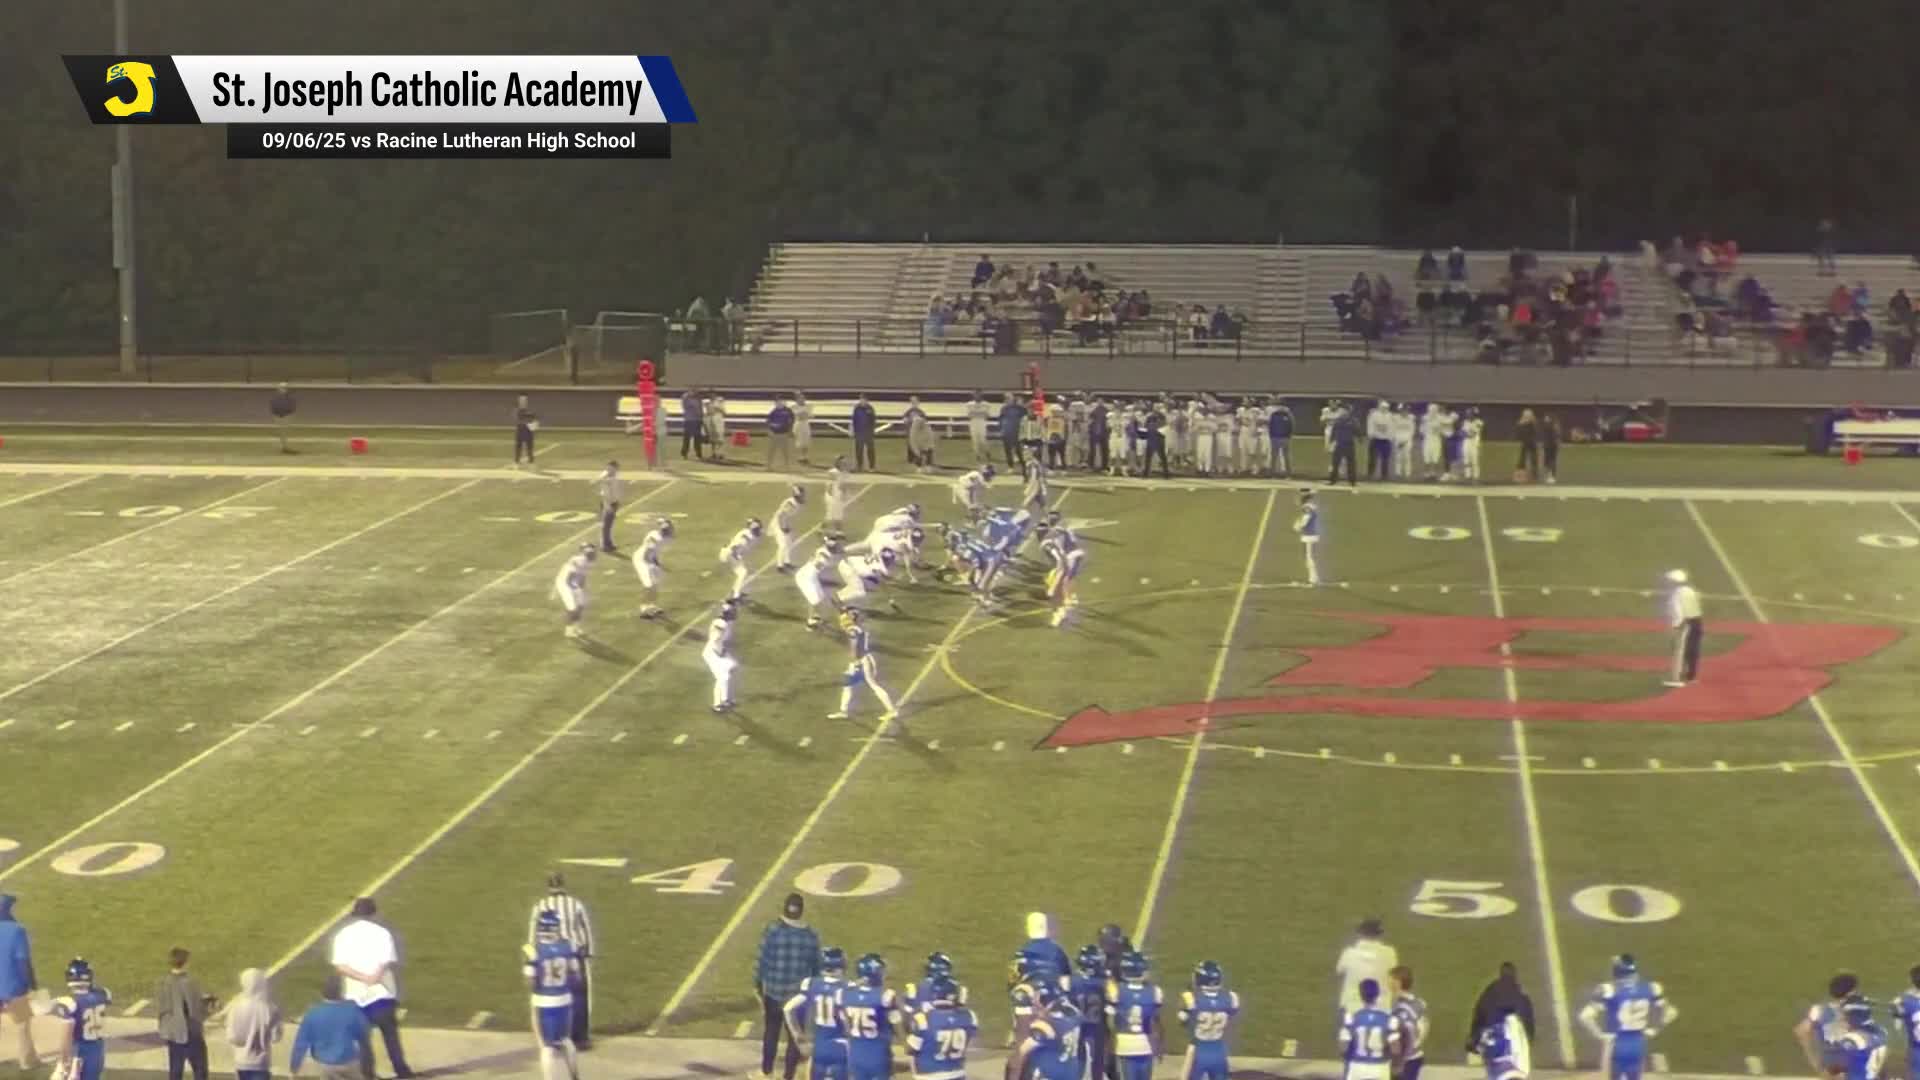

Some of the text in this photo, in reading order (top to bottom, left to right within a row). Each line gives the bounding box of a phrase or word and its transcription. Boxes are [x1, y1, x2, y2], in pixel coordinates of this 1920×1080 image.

[814, 995, 837, 1027] 11
[847, 1006, 879, 1039] 75
[1194, 1010, 1230, 1041] 22
[934, 1028, 968, 1061] 79
[1355, 1025, 1385, 1058] 14
